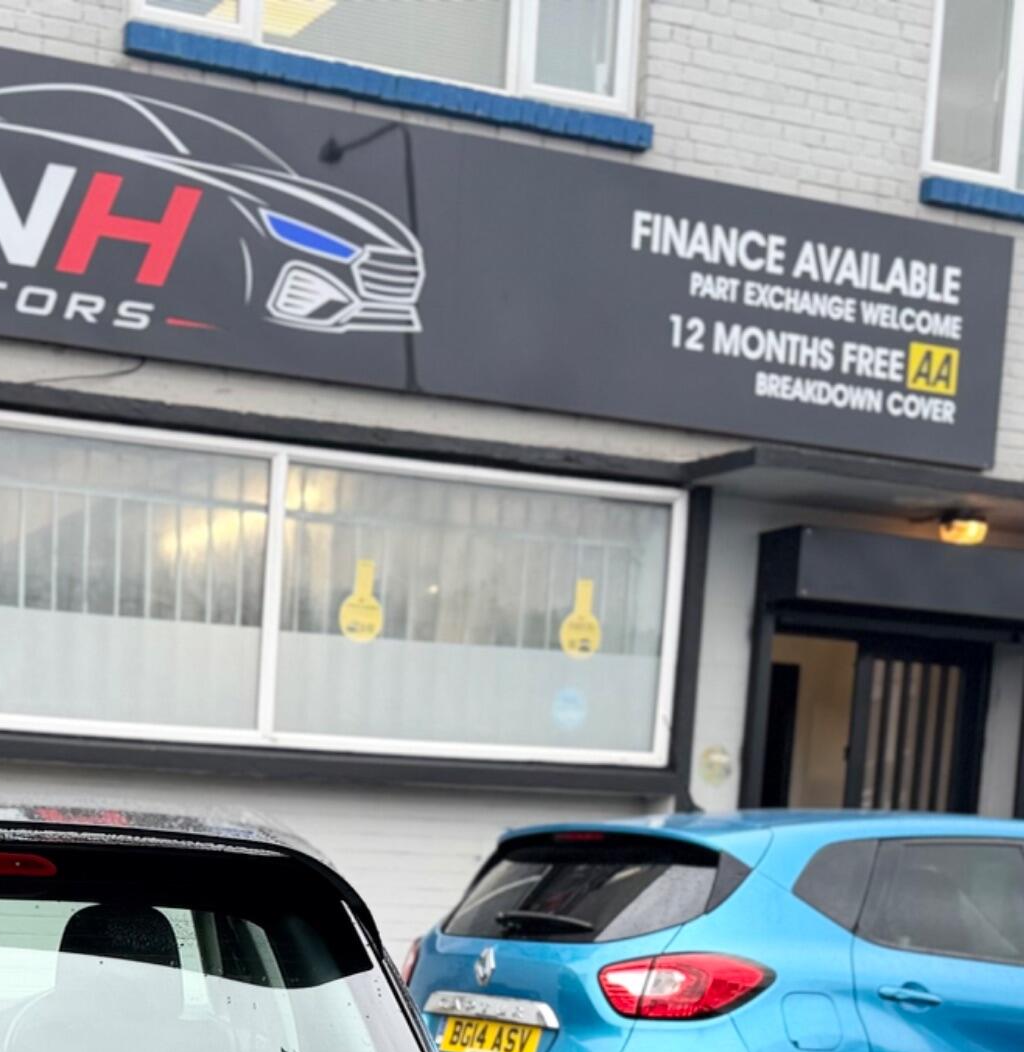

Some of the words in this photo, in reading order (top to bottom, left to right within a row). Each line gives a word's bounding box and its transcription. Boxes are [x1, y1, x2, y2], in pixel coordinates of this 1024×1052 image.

[631, 210, 787, 275] FINANCE
[793, 241, 962, 305] AVAILABLE
[689, 272, 740, 304] PART
[743, 281, 857, 323] EXCHANGE
[861, 301, 963, 340] WELCOME
[669, 314, 706, 352] 12
[713, 321, 835, 372] MONTHS
[842, 342, 906, 383] FREE
[911, 350, 952, 389] AA
[755, 372, 883, 414] BREAKDOWN
[887, 392, 957, 425] COVER
[448, 1020, 488, 1050] BG14
